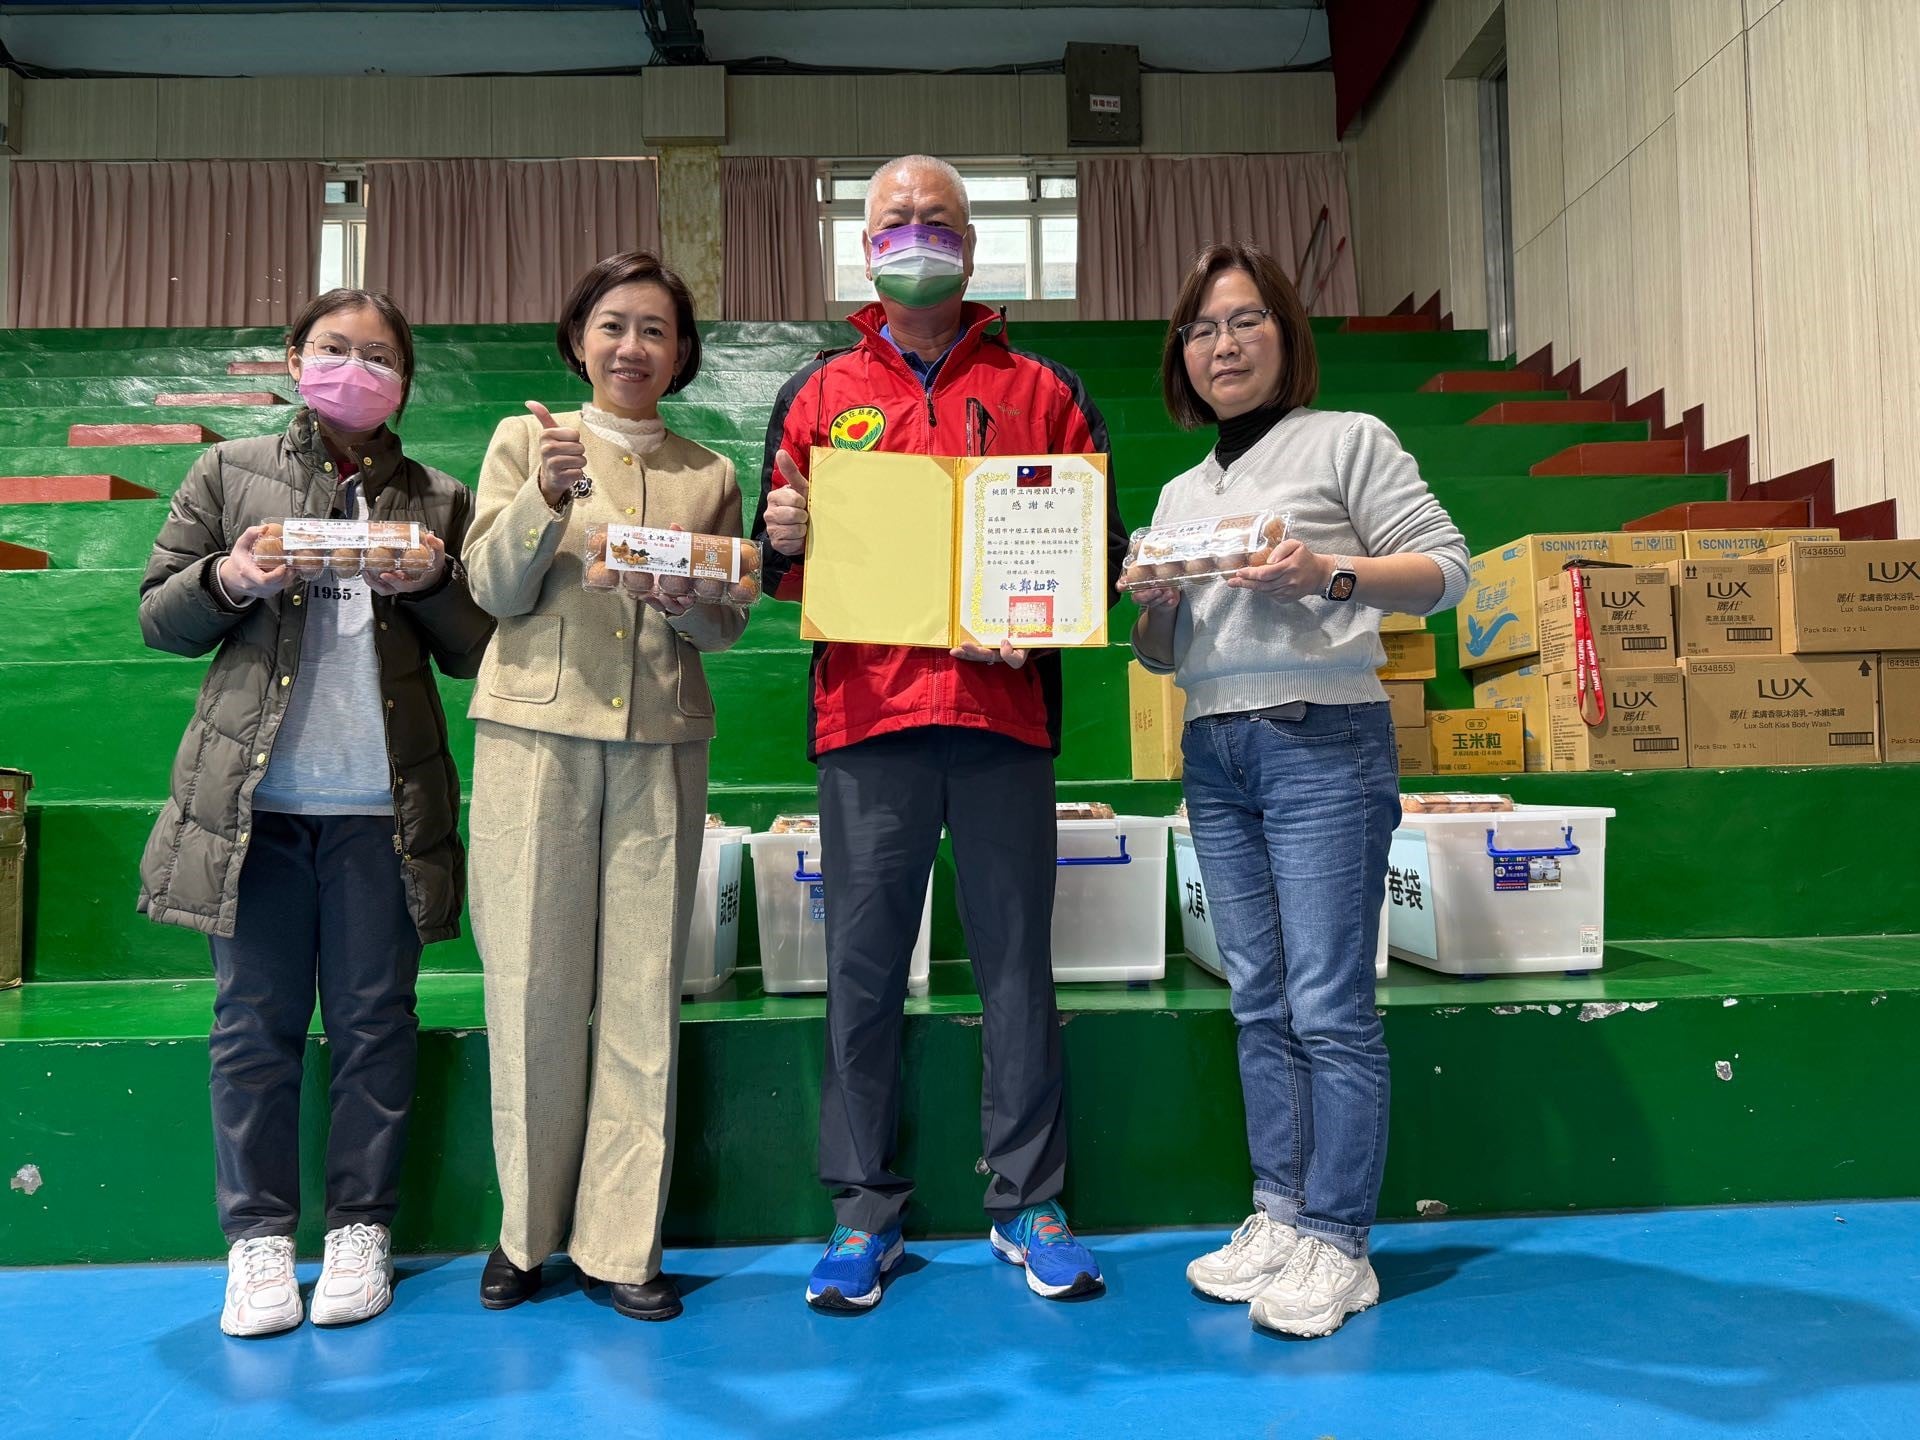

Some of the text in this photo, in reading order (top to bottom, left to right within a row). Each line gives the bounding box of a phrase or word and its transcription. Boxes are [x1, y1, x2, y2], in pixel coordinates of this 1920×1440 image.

[1011, 500, 1056, 510] 感謝狀
[1541, 540, 1608, 552] 1SCNN12TRA
[1697, 538, 1766, 550] 1SCNN12TRA
[1801, 547, 1844, 556] 64348550
[1868, 561, 1920, 583] LUX
[1707, 582, 1752, 599] LUX
[1601, 591, 1645, 609] LUX
[1692, 664, 1734, 673] 64348553
[1758, 678, 1814, 700] LUX
[1612, 691, 1658, 709] LUX
[1759, 721, 1773, 729] Soft
[1775, 721, 1790, 729] Kiss
[1792, 721, 1810, 729] Body
[1812, 720, 1832, 728] Wash
[1452, 733, 1502, 750] 玉米粒
[1389, 864, 1423, 910] 卷袋
[1186, 876, 1206, 923] 文具
